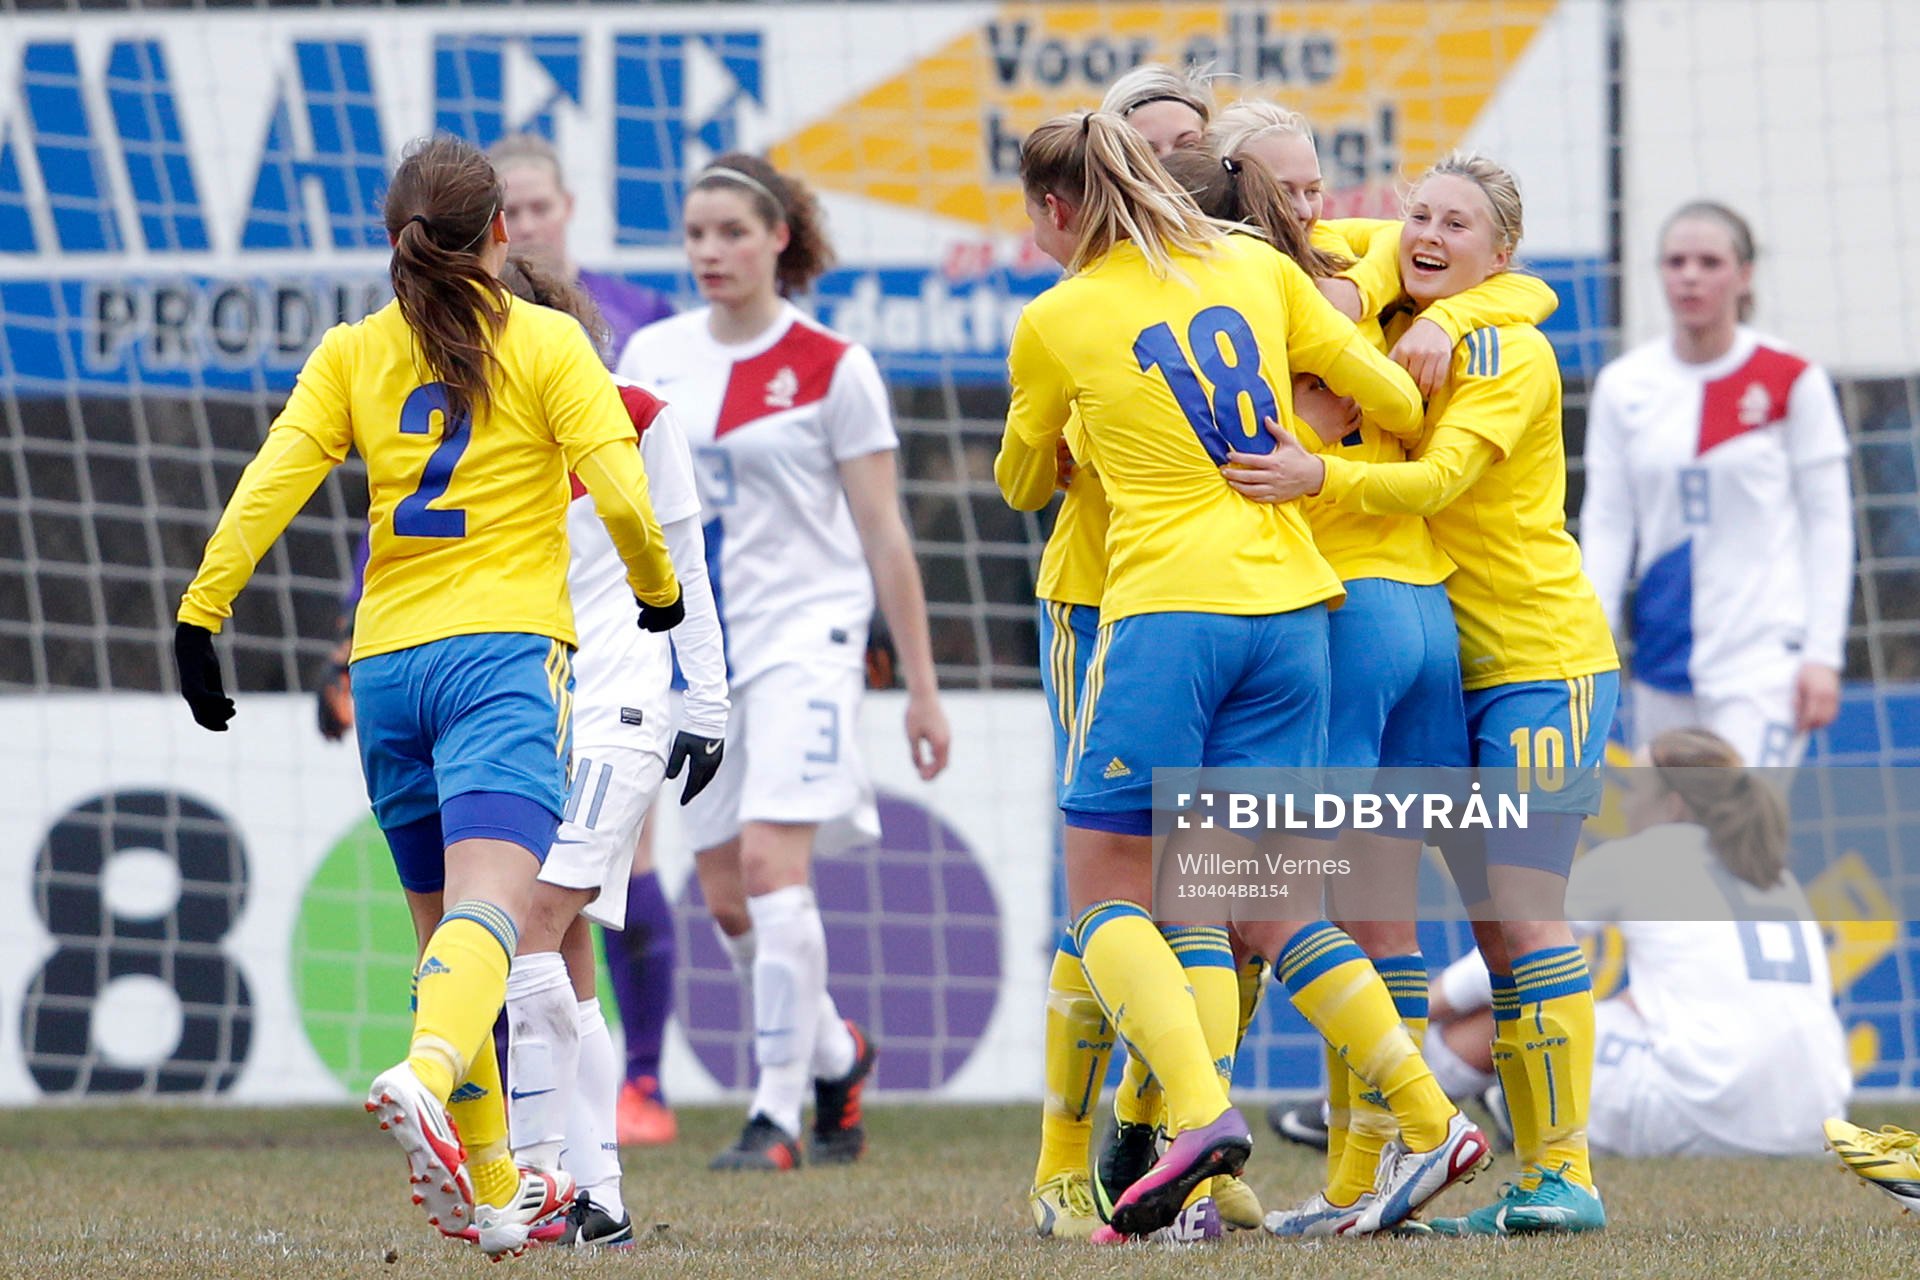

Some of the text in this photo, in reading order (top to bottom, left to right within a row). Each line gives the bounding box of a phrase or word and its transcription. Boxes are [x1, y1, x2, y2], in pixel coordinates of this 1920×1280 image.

[986, 12, 1335, 86] Voor elke
[1132, 305, 1278, 467] 18
[393, 382, 473, 538] 2
[697, 447, 737, 508] 3
[1677, 466, 1712, 526] 8
[806, 699, 839, 765] 3
[1510, 726, 1565, 793] 10
[563, 757, 613, 830] 11
[18, 786, 256, 1096] 8
[1702, 854, 1813, 985] 6
